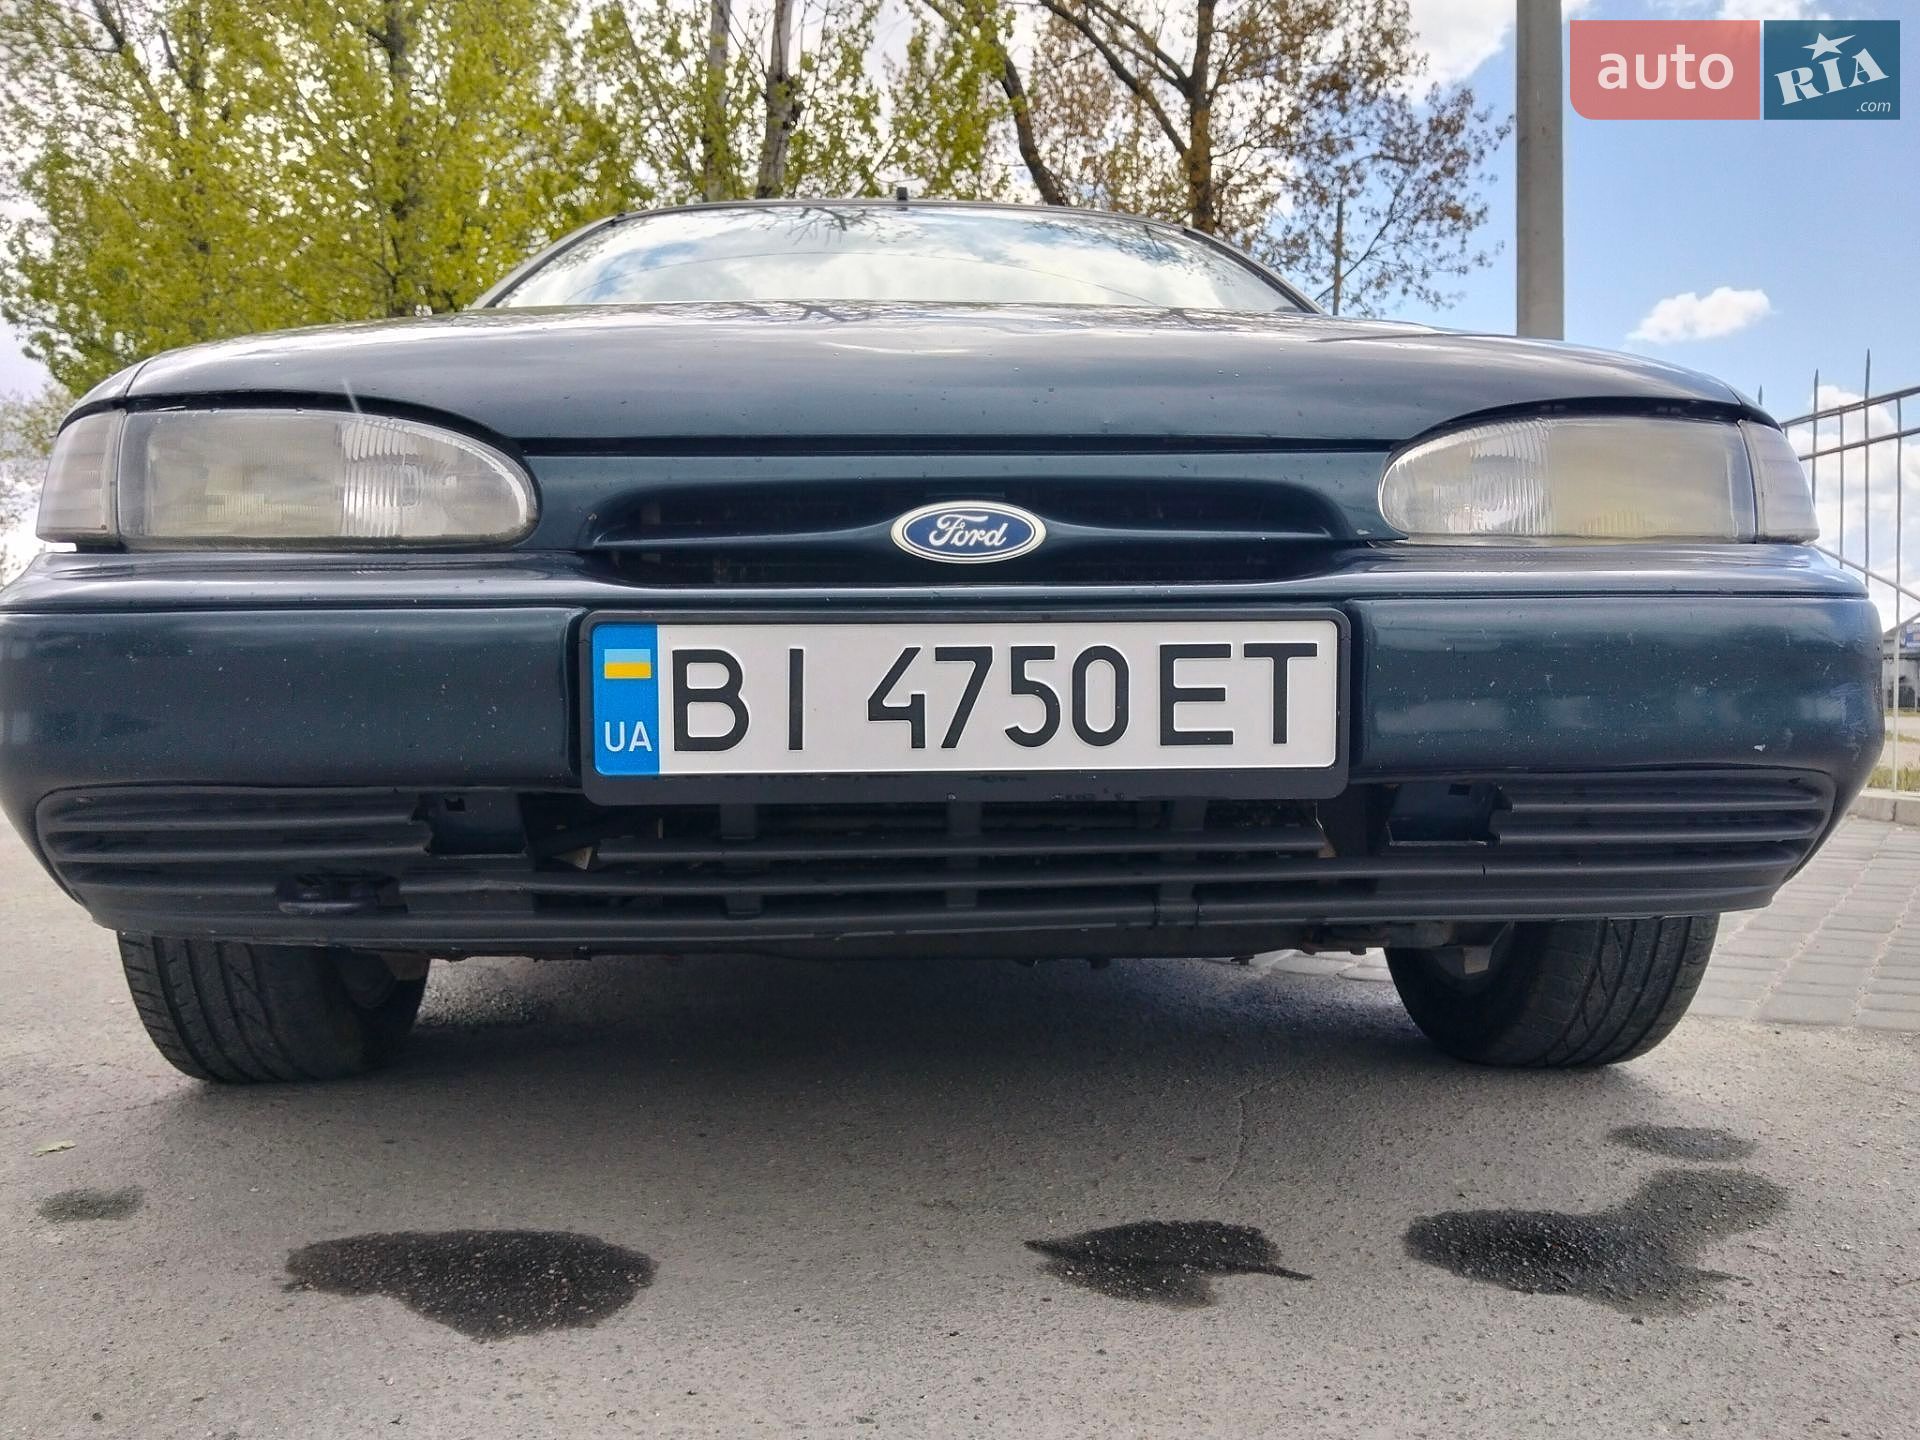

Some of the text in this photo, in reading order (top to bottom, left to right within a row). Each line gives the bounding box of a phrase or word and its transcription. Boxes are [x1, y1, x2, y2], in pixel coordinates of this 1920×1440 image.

[928, 513, 1009, 547] Ford
[671, 642, 1318, 752] BI 4750 ET
[604, 721, 653, 752] UA
